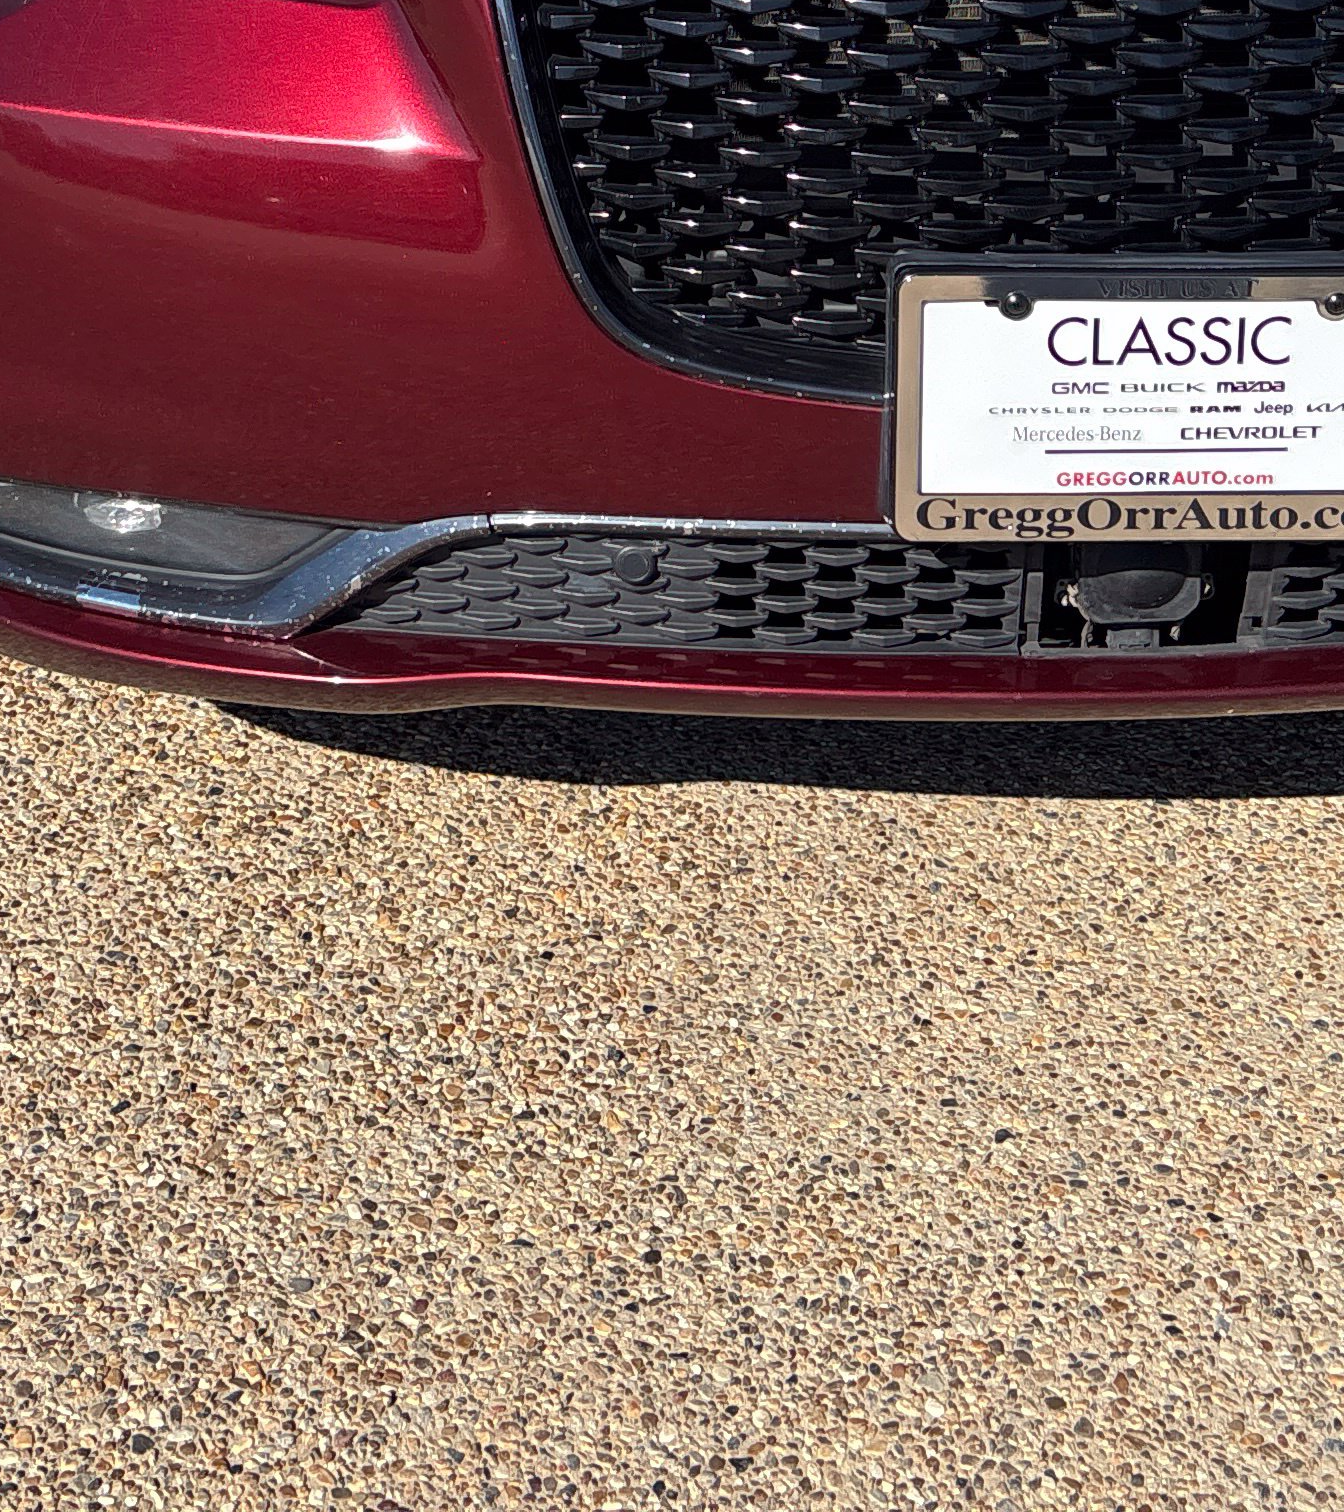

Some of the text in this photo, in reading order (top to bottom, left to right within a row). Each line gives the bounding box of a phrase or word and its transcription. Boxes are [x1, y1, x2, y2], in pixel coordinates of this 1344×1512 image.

[1047, 316, 1292, 366] CLASSIC
[1051, 381, 1110, 395] GMC
[1120, 383, 1205, 393] BUICK
[988, 406, 1091, 414] CHRYSLER
[1103, 406, 1178, 414] DODGE
[1190, 405, 1242, 414] RAM
[1253, 401, 1294, 416] Jeep
[1012, 425, 1323, 442] Mercedes-Benz CHEVROLET
[1056, 471, 1273, 487] GREGGORRAUTO.com
